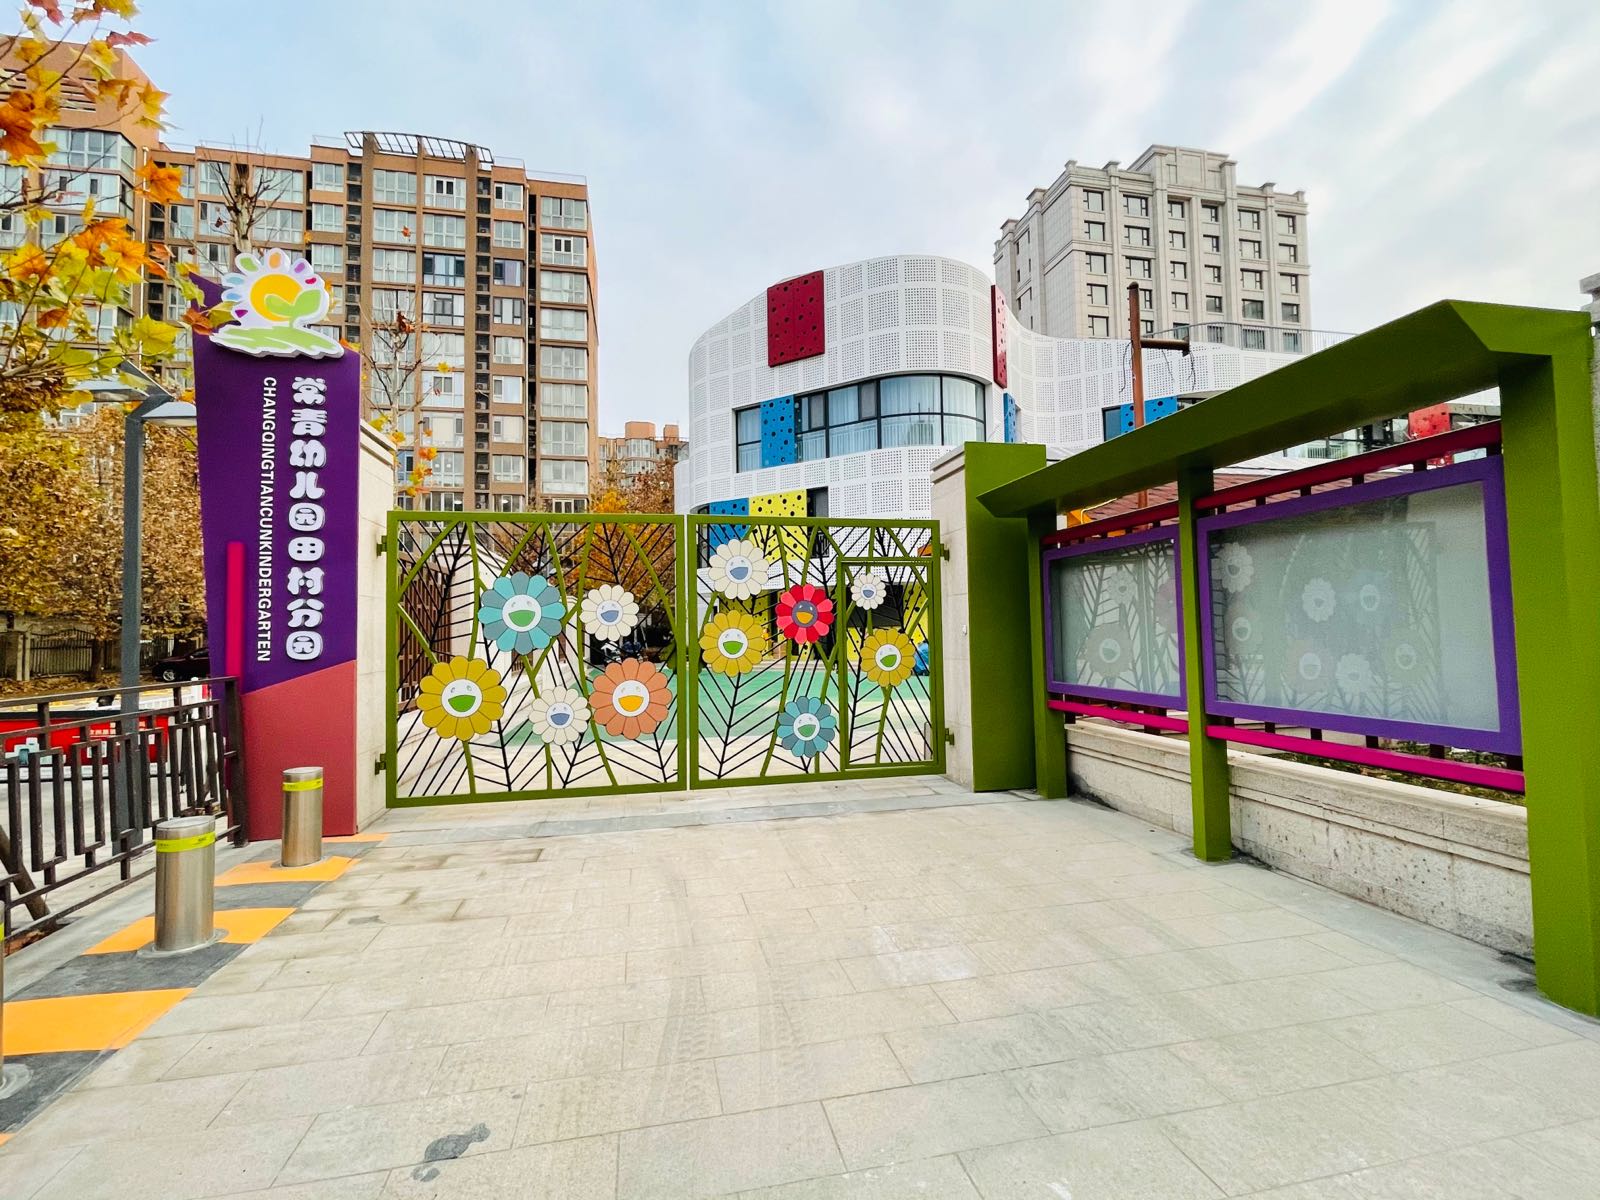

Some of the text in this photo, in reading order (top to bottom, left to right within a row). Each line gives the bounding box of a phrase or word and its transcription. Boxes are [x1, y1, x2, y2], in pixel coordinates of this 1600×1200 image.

[286, 376, 327, 661] 常青幼儿园田村分园
